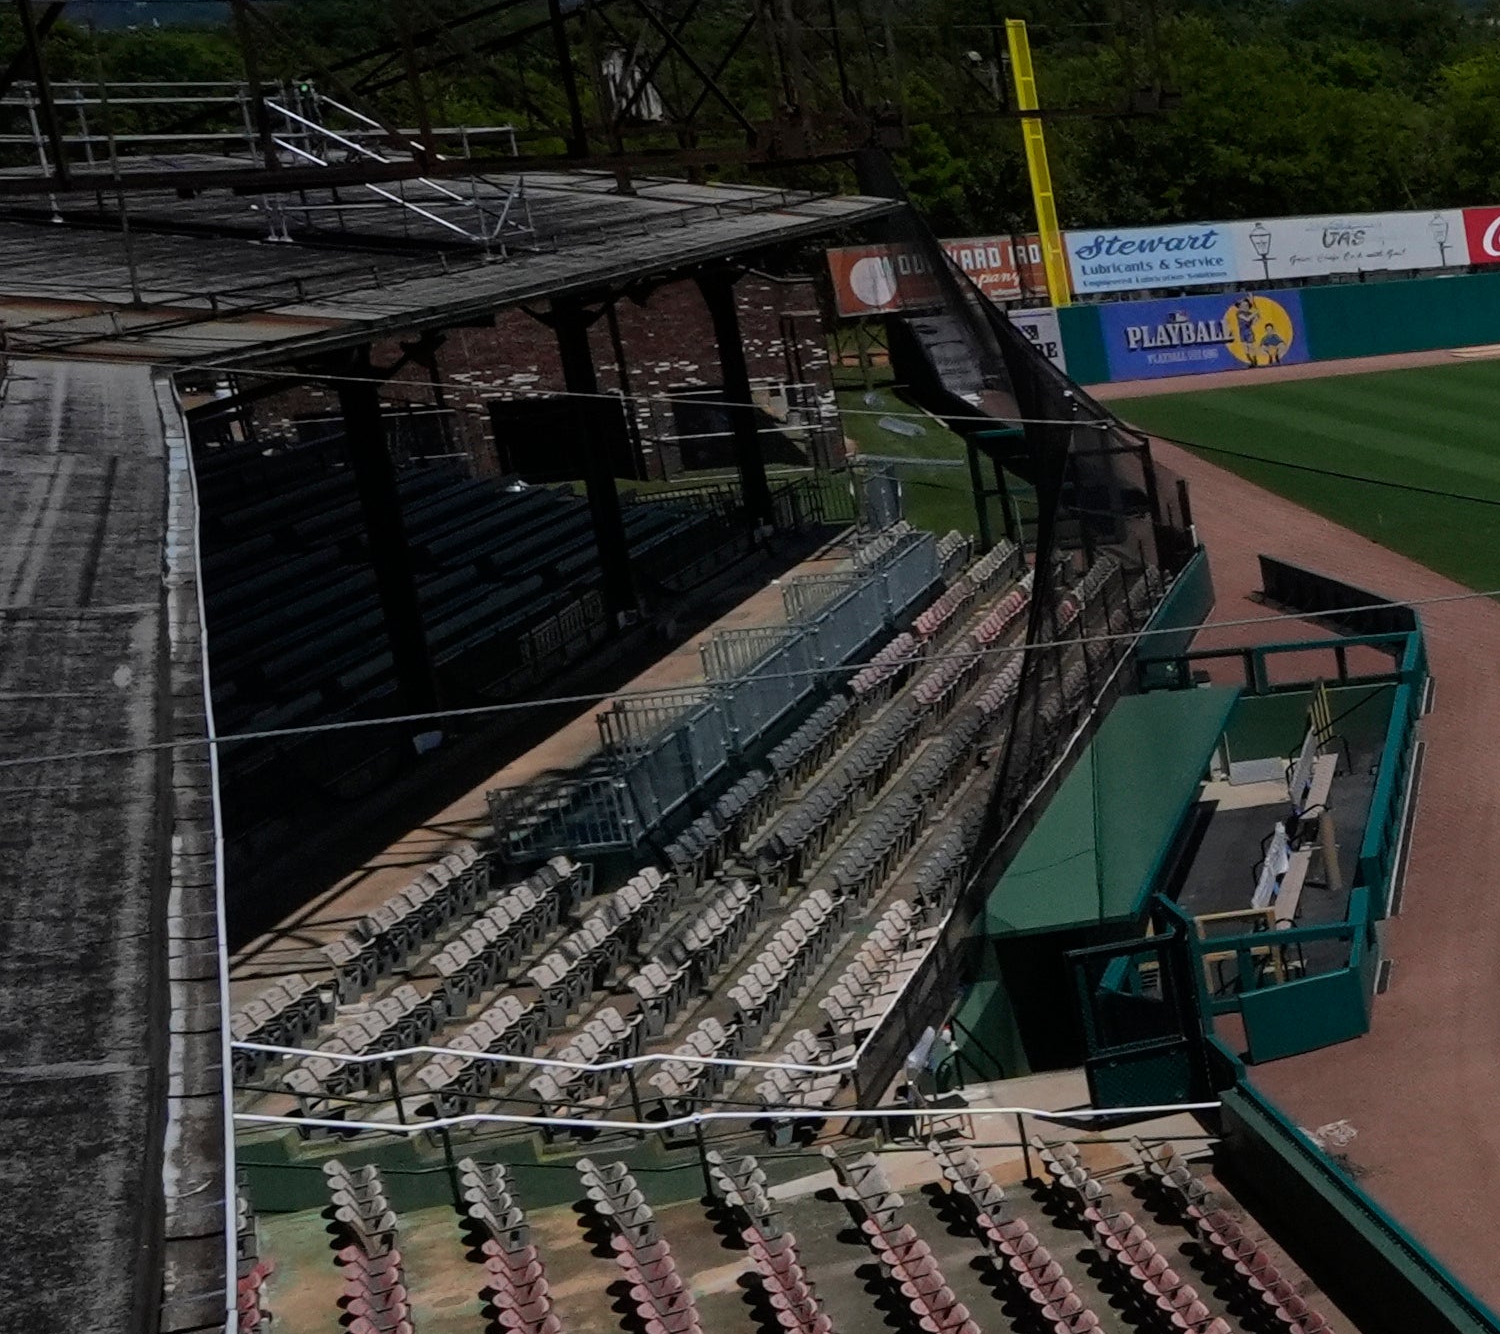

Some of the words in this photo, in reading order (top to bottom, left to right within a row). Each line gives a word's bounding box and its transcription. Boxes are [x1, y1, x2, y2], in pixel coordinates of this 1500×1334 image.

[1075, 229, 1219, 260] Stewart
[1082, 260, 1153, 276] Lubricants
[1159, 258, 1171, 270] &
[1174, 255, 1224, 269] Service
[1126, 319, 1235, 350] PLAYBALL
